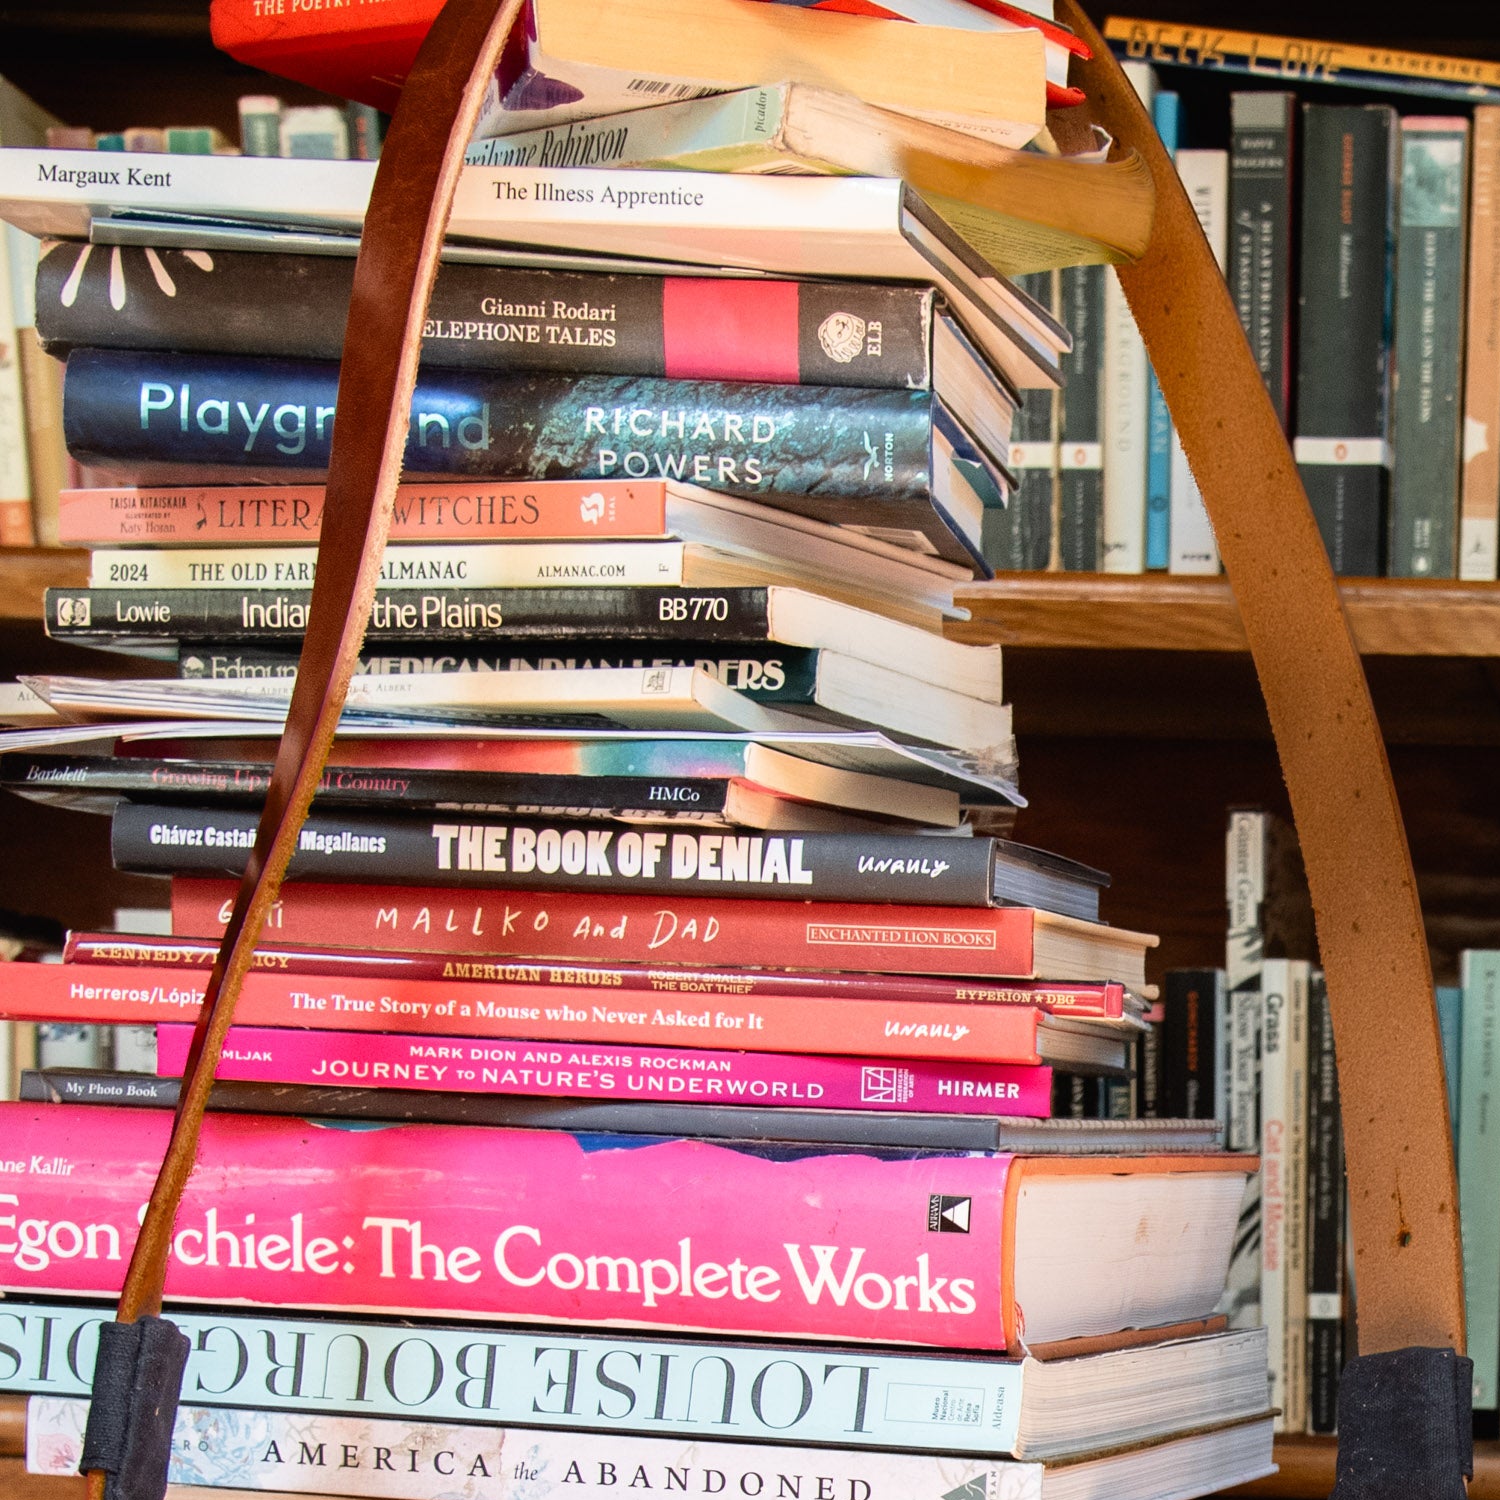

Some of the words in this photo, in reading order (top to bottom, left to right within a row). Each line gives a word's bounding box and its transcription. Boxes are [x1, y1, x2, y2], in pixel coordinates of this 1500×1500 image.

[1247, 37, 1344, 80] LOVE
[37, 163, 121, 189] Margaux
[127, 167, 172, 188] Kent
[492, 181, 528, 201] The
[534, 183, 594, 203] Illness
[600, 185, 704, 207] Apprentice
[481, 298, 546, 319] Gianni
[552, 300, 617, 322] Rodari
[139, 382, 490, 456] Playgrnd
[585, 407, 776, 444] RICHARD
[599, 450, 763, 485] POWERS
[116, 600, 171, 622] Lowie
[372, 597, 418, 629] the
[422, 597, 502, 630] Plains
[26, 766, 89, 782] Bartoletti
[150, 824, 203, 847] Chávez
[300, 831, 387, 856] Magallanes
[432, 824, 507, 873] THE
[512, 827, 612, 876] BOOK
[617, 830, 666, 880] OF
[670, 833, 813, 885] DENIAL
[648, 910, 722, 951] DAD
[810, 927, 901, 944] ENCHANTED
[904, 929, 940, 944] LION
[943, 930, 993, 946] BOOKS
[410, 1045, 464, 1060] MARK
[470, 1048, 516, 1062] DION
[525, 1052, 562, 1065] AND
[568, 1053, 633, 1068] ALEXIS
[640, 1056, 731, 1072] ROCKMAN
[938, 1080, 1021, 1100] HIRMER
[29, 1155, 75, 1177] Kallir
[137, 1201, 356, 1276] chiele:
[363, 1216, 482, 1285] The
[494, 1224, 782, 1308] Complete
[784, 1243, 976, 1315] Works
[532, 1346, 880, 1434] LOUISE
[262, 1444, 493, 1479] AMERICA
[514, 1462, 539, 1482] the
